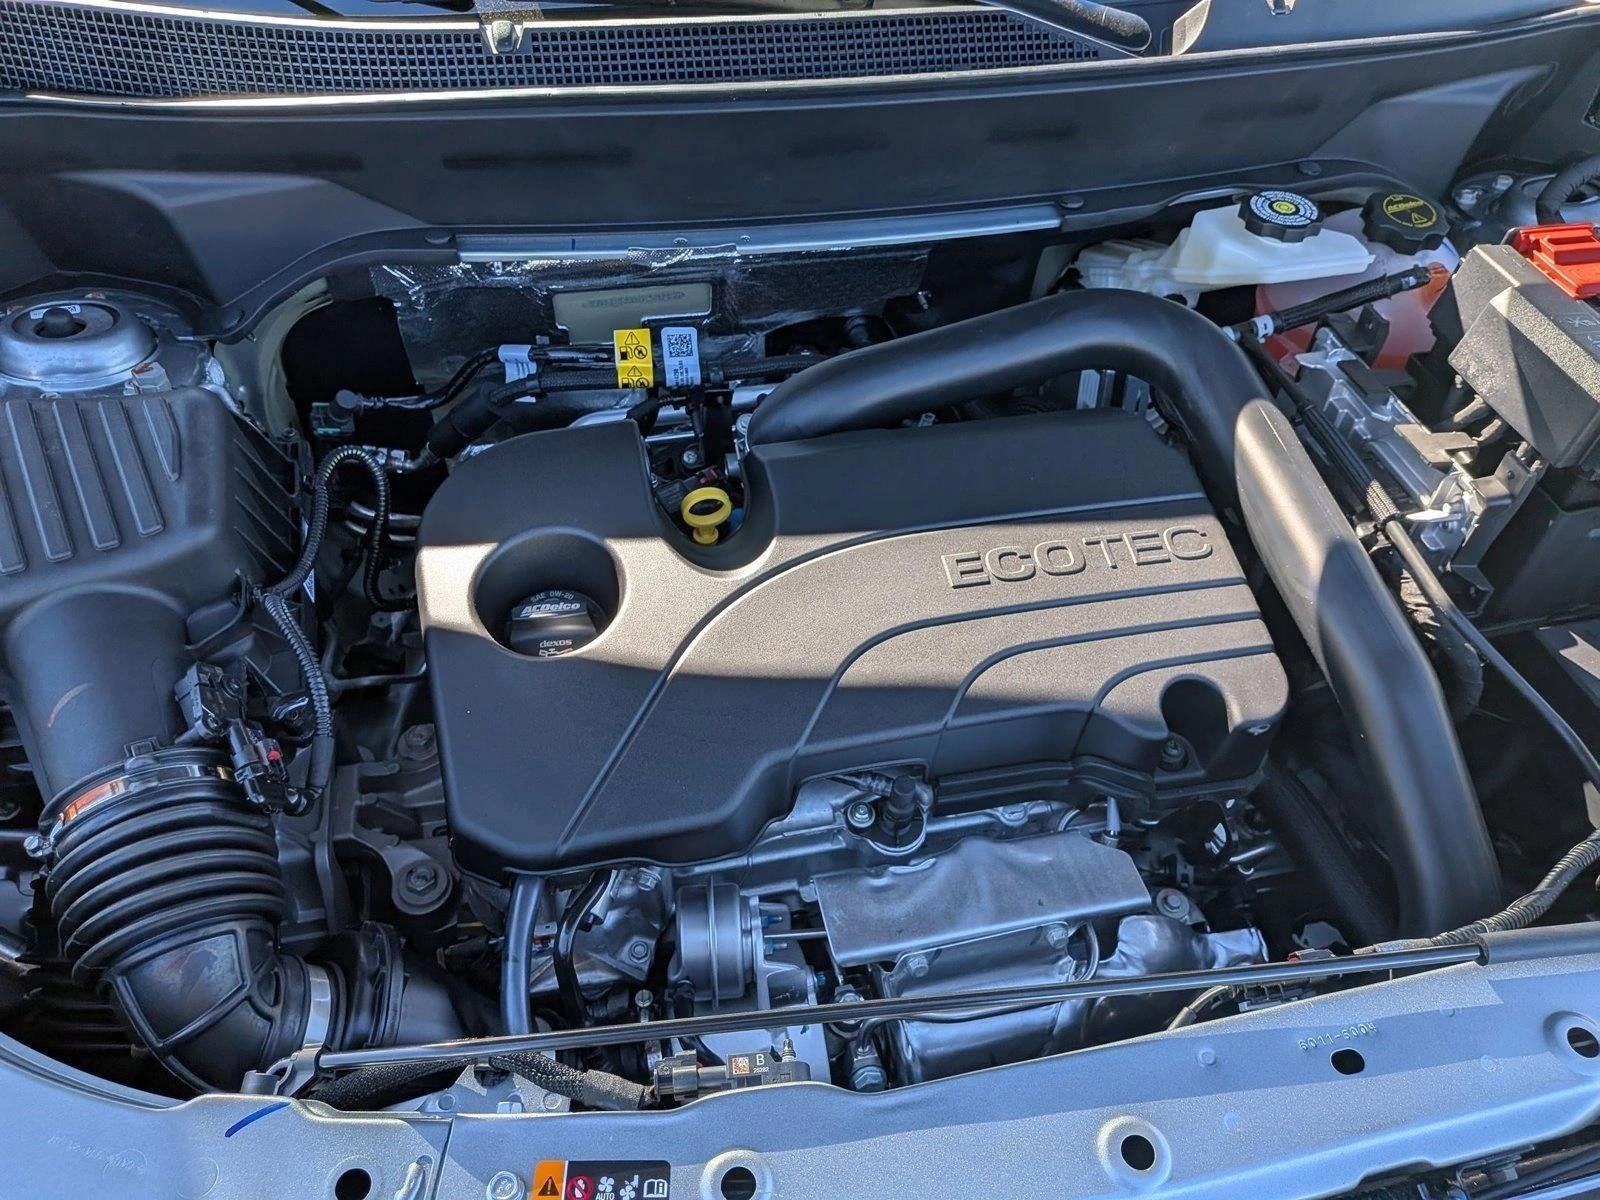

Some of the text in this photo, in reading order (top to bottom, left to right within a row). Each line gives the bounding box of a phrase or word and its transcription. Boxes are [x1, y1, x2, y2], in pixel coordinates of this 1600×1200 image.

[941, 525, 1213, 589] ECOTEC
[521, 602, 581, 615] ACDelco
[539, 639, 573, 648] dexos
[756, 1054, 765, 1066] B
